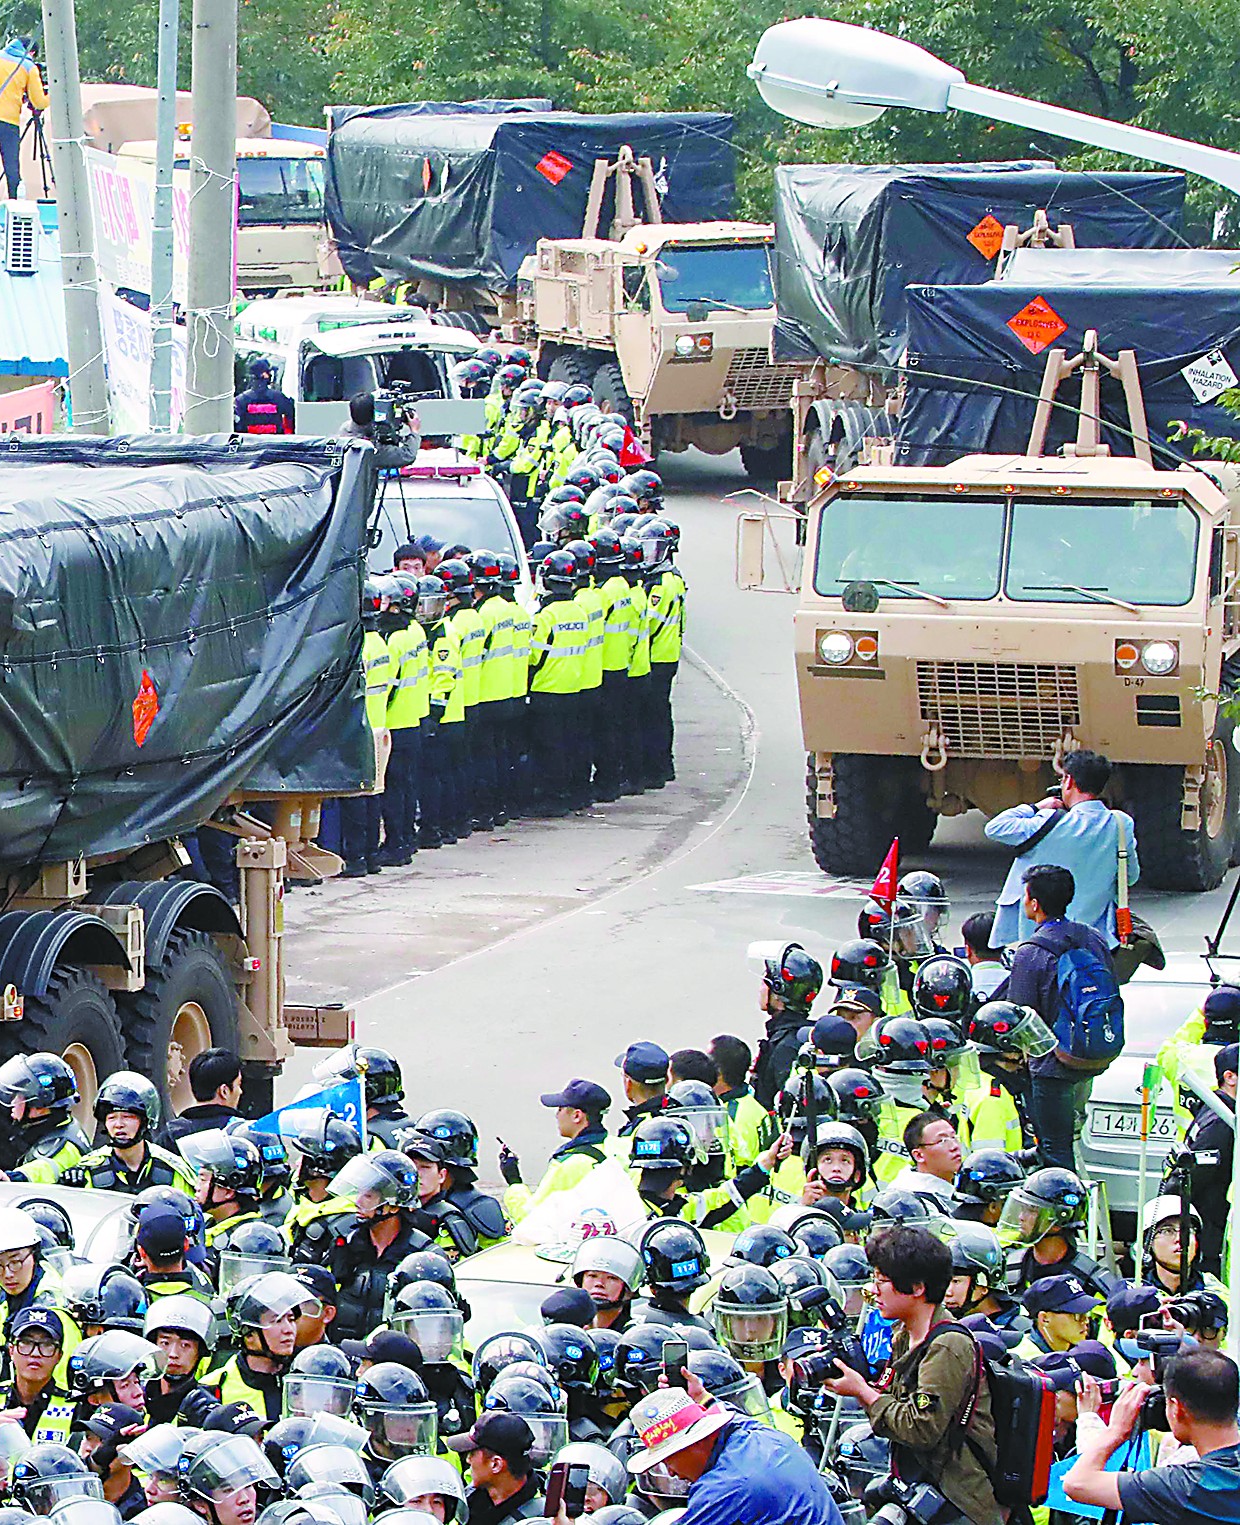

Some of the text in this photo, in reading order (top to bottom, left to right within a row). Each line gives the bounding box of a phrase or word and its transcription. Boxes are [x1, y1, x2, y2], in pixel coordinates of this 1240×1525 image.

[1188, 367, 1232, 383] INHALATION
[1192, 377, 1223, 390] HAZARD
[1201, 389, 1208, 397] 6
[879, 867, 891, 884] 2
